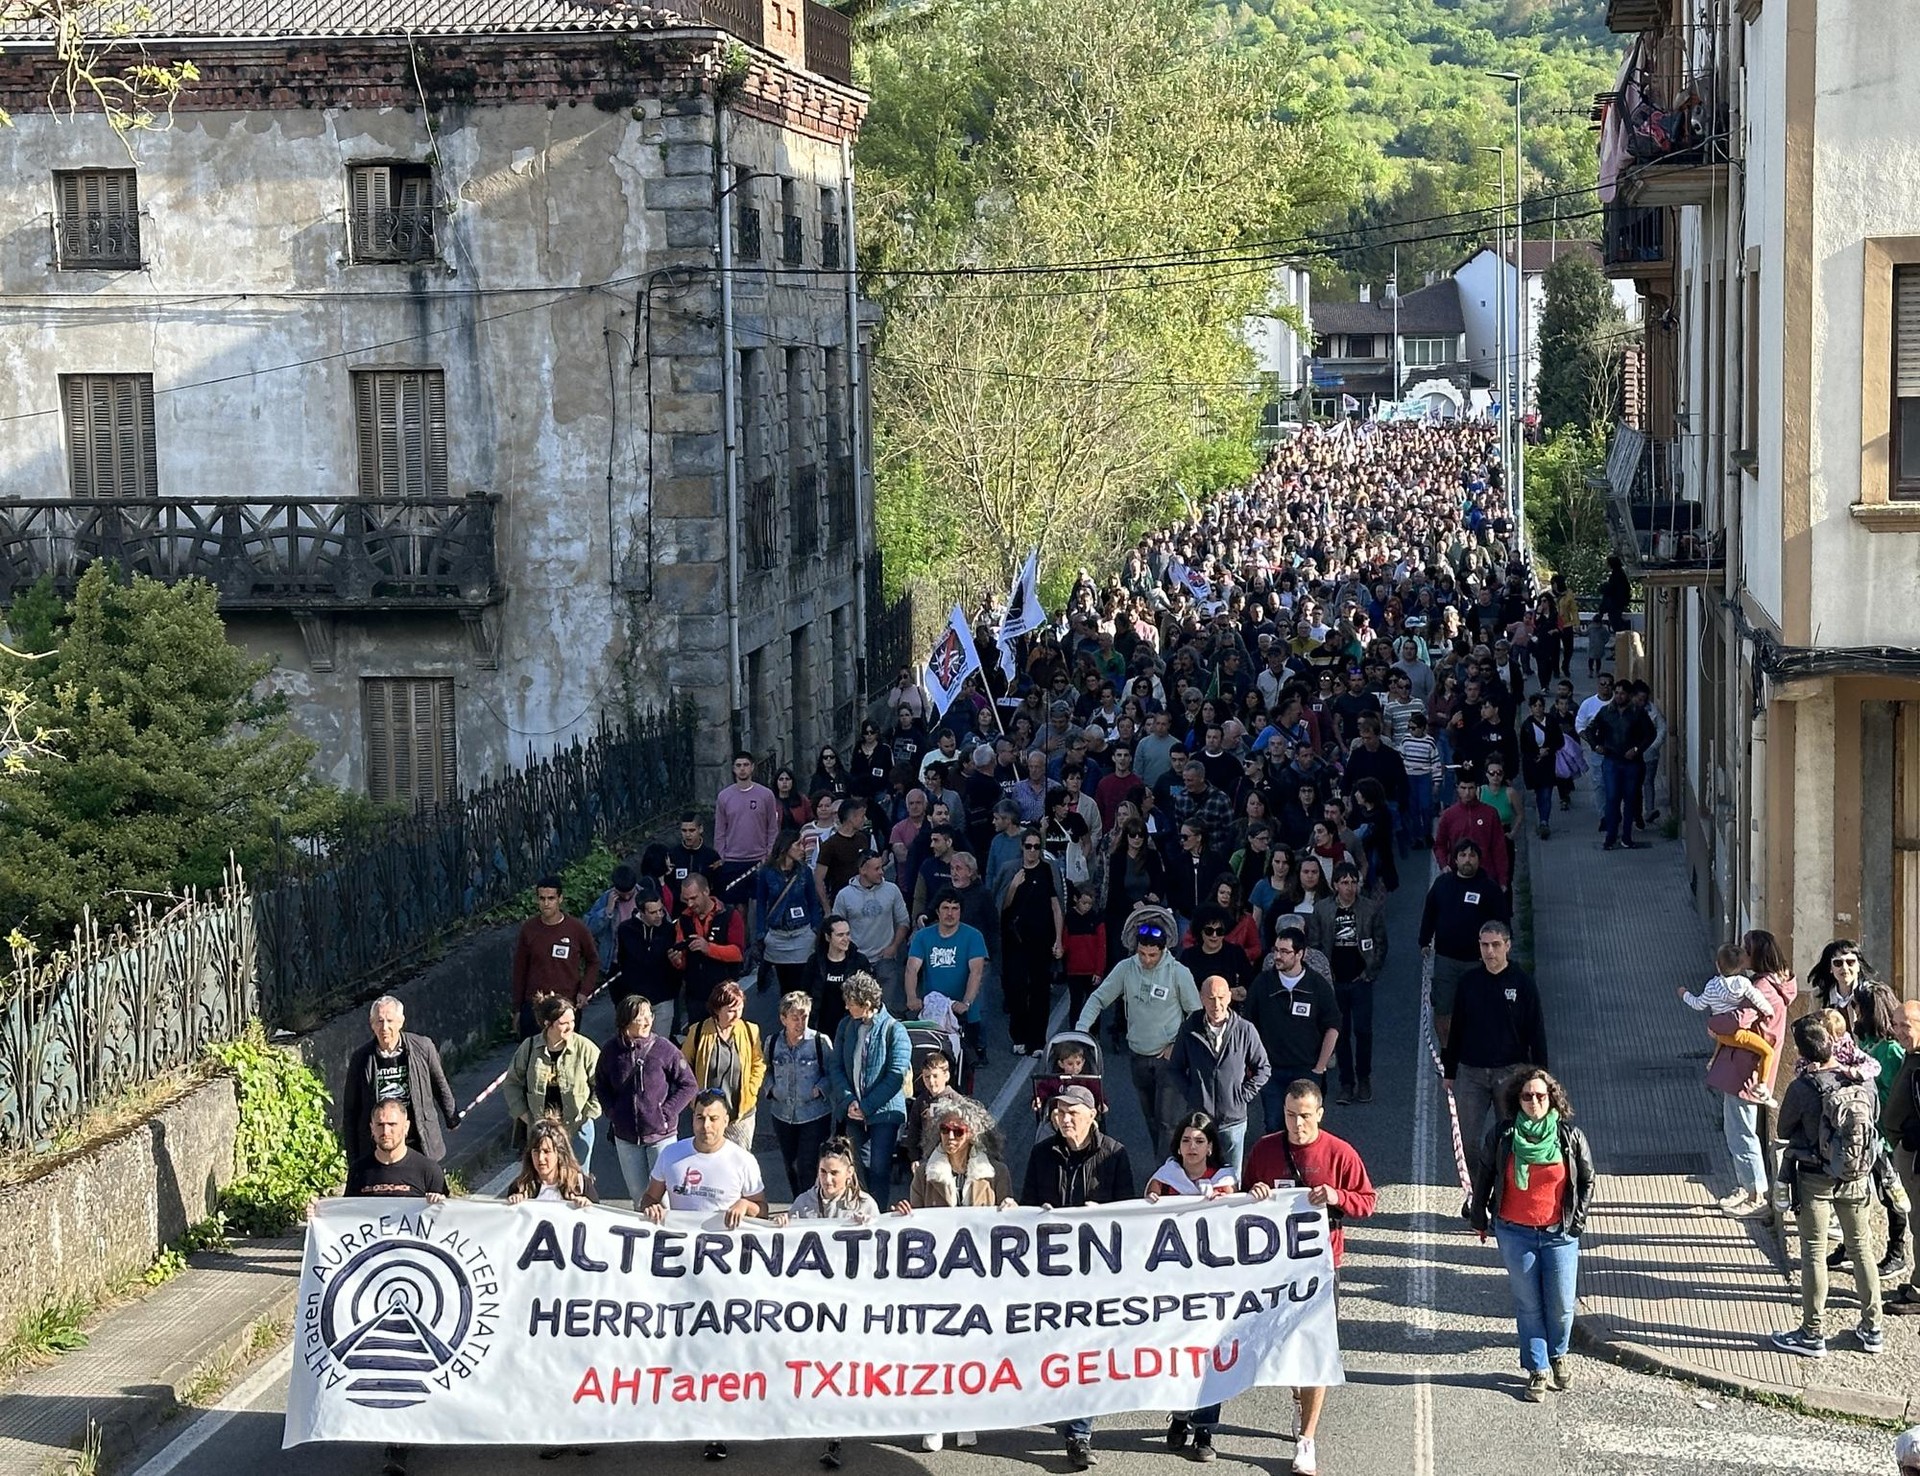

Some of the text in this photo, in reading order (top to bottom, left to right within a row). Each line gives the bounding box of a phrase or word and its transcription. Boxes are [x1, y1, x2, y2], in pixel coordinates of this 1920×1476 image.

[516, 1210, 1324, 1280] ALTERNATIBAREN ALDE
[303, 1213, 500, 1391] AHTaren AURREAN ALTERNATIBA
[528, 1275, 1319, 1338] HERRITARRON HITZA ERRESPETATU
[571, 1338, 1240, 1403] AHTaren TXIKIZIOA GELDITU
